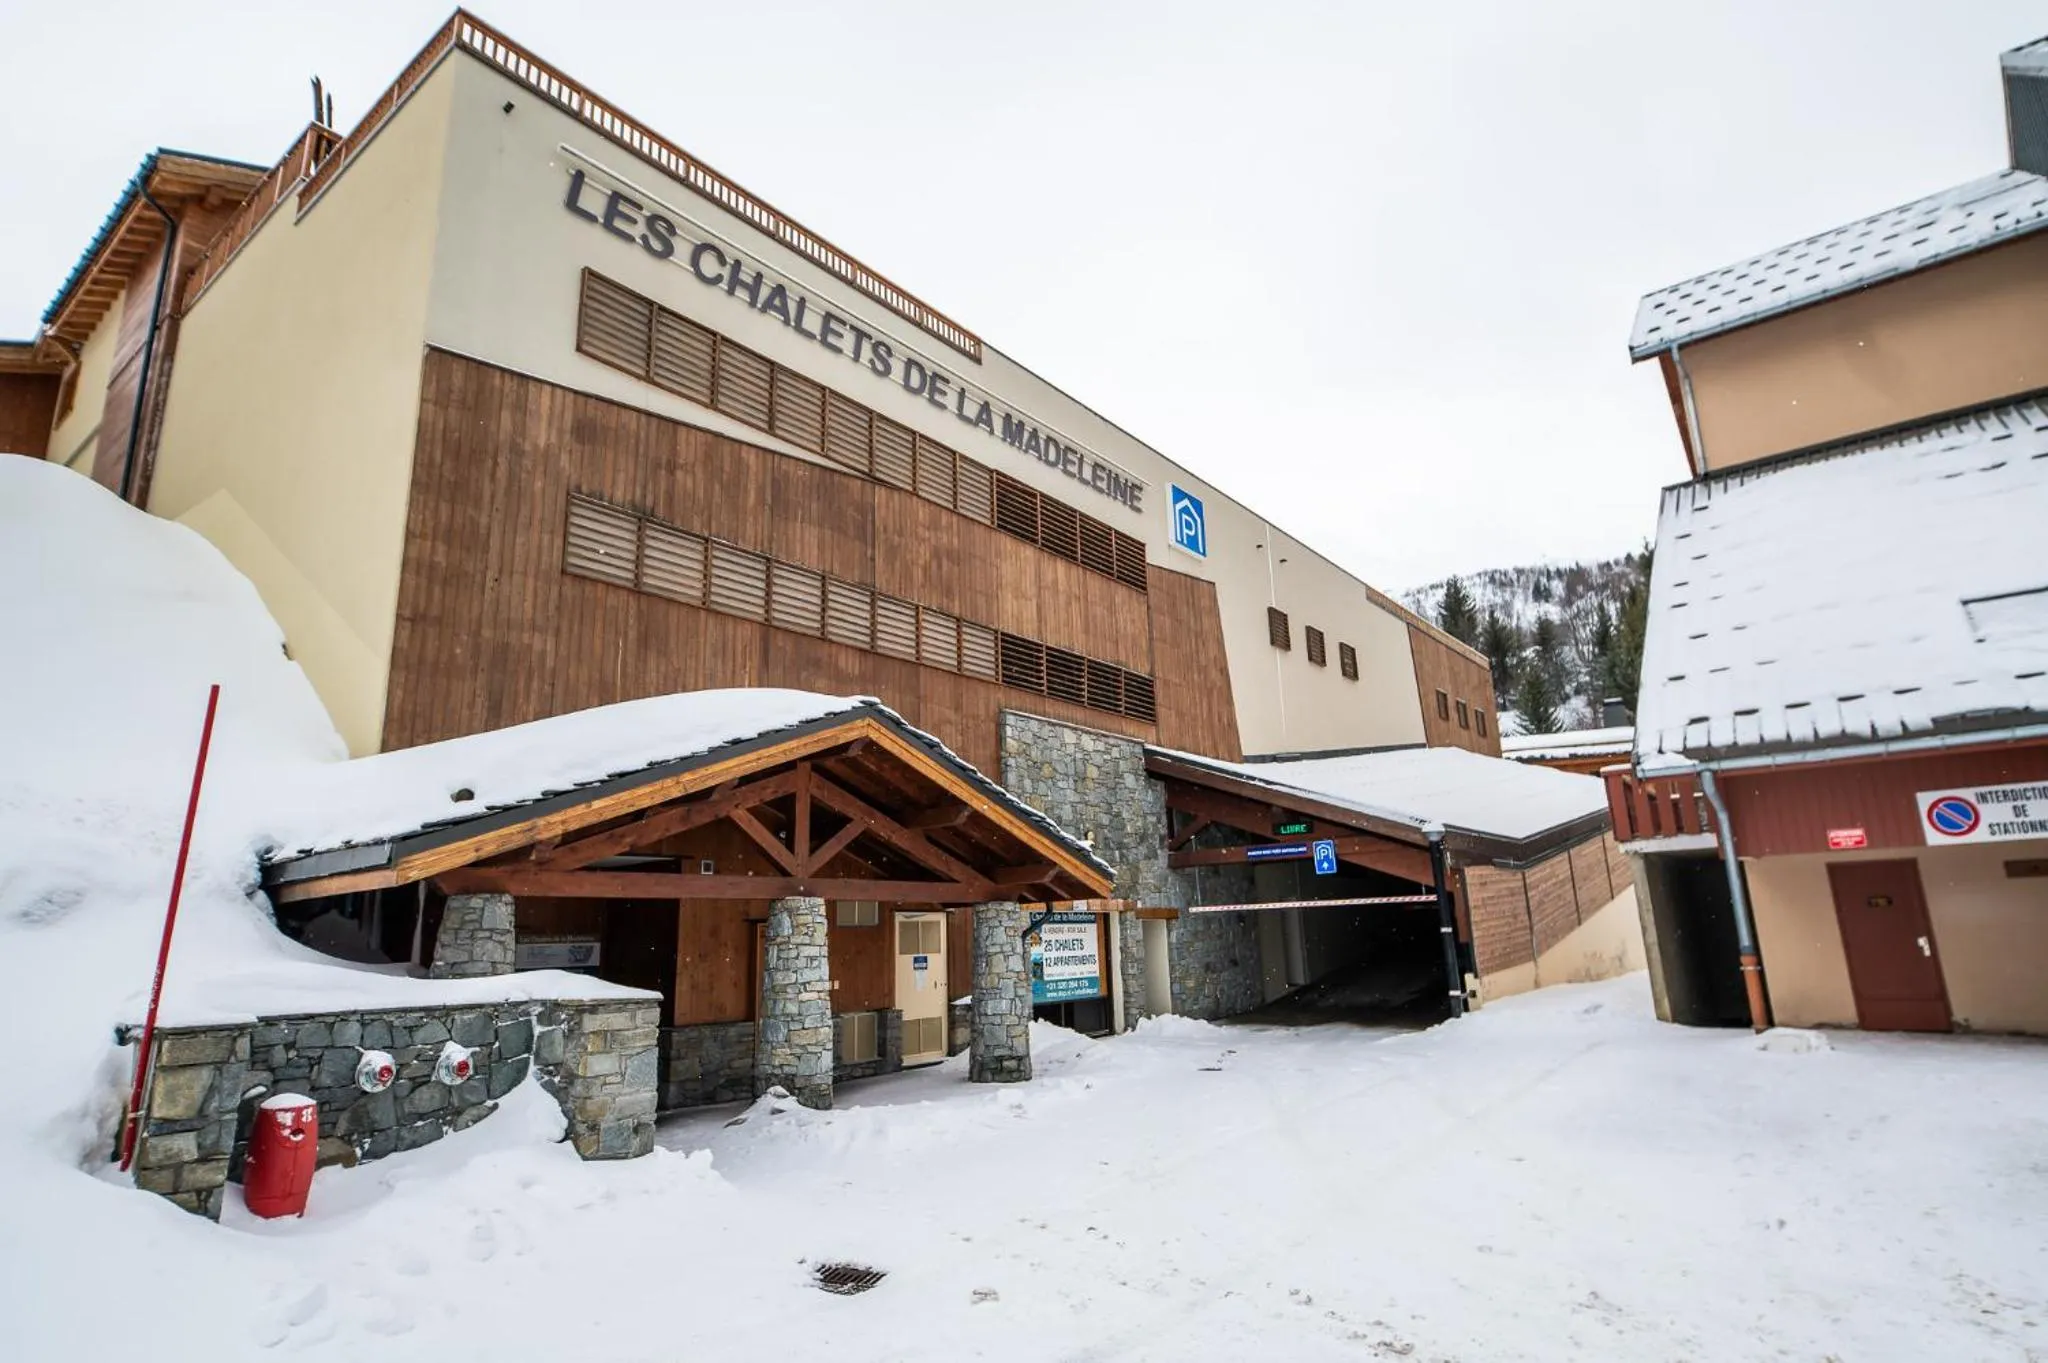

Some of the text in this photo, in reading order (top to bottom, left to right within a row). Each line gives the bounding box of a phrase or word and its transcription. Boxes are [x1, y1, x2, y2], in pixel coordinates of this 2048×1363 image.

[565, 169, 1144, 514] LES CHALETS DE LA MADELEINE
[2012, 804, 2029, 818] DE
[1988, 820, 2048, 836] STATIONN
[1044, 938, 1084, 952] 25 CHALETS
[1045, 954, 1096, 968] 12 APPARTEMENTS
